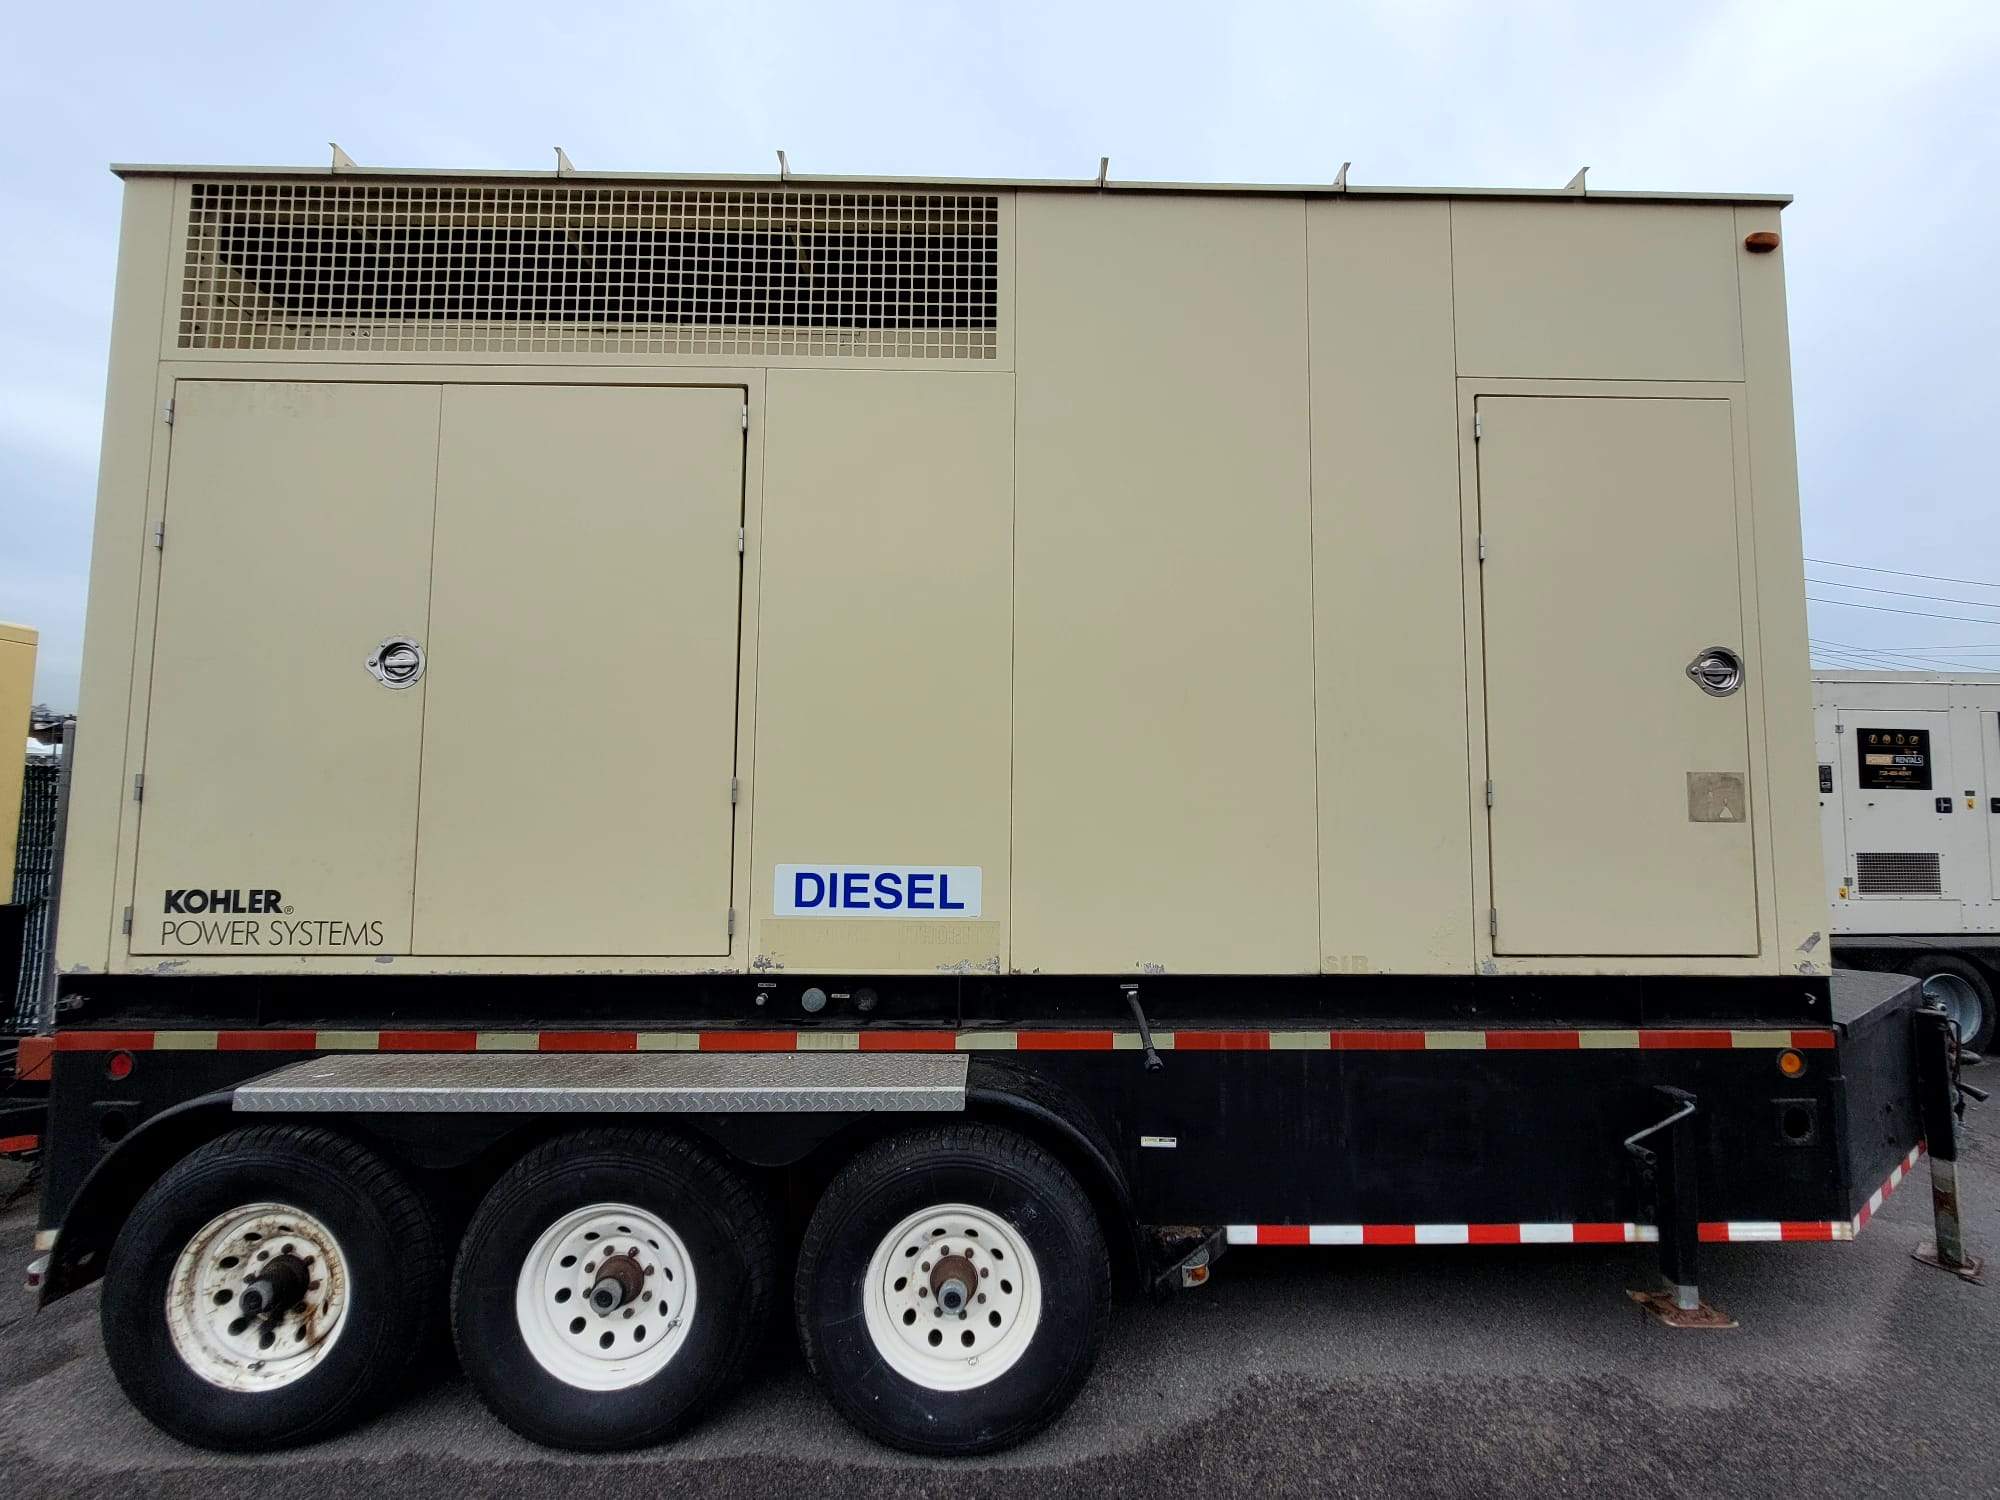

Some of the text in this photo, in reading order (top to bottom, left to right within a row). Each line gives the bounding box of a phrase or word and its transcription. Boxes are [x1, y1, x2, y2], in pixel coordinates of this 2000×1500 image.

[794, 872, 965, 910] DIESEL
[161, 920, 384, 946] POWER SYSTEMS
